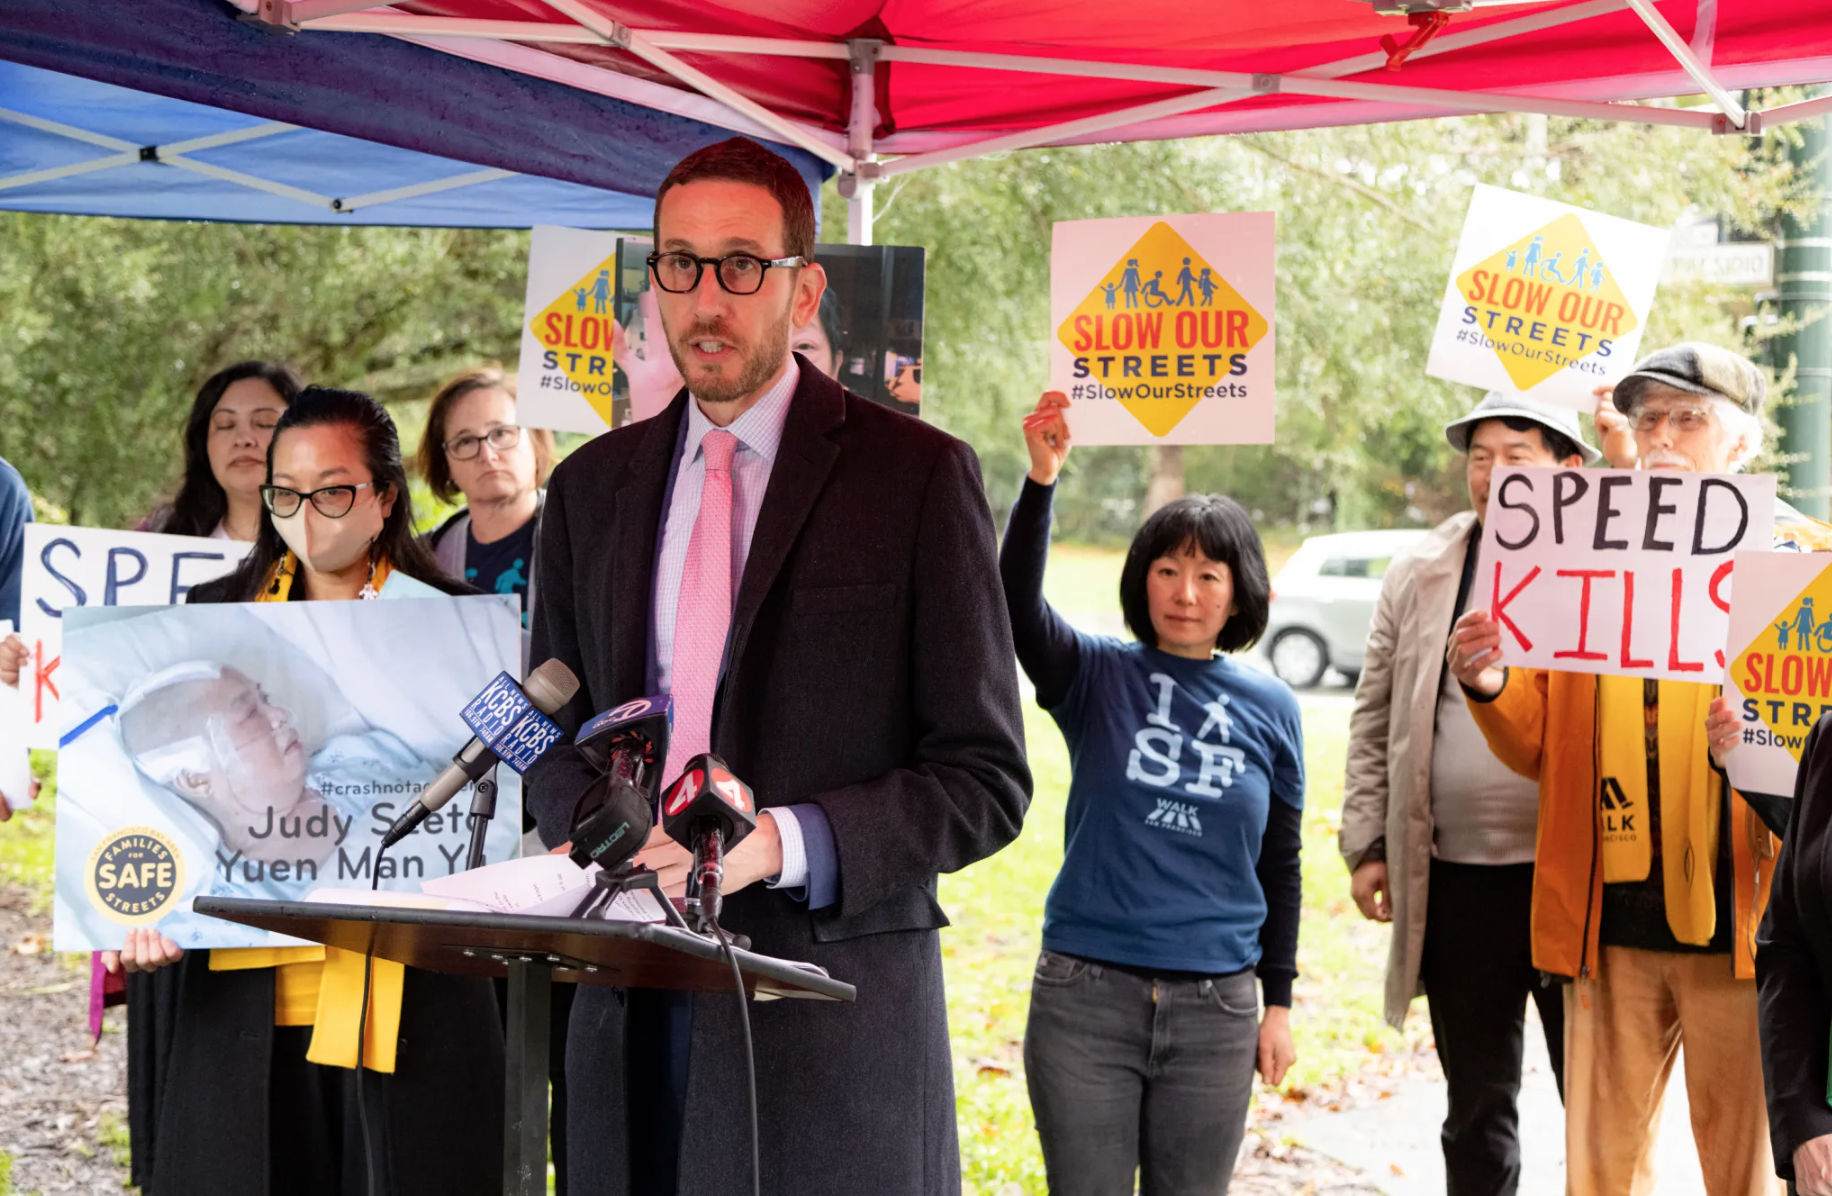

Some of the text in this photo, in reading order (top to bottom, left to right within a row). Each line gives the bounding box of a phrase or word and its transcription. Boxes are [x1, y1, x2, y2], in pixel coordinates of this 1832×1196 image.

[1468, 269, 1625, 336] SLOW OUR
[1073, 309, 1249, 352] SLOW OUR
[1462, 306, 1613, 357] STREETS
[1072, 353, 1248, 379] STREETS
[1456, 329, 1607, 377] #SlowOurStreets
[1071, 382, 1248, 400] #SlowOurStreets
[1494, 471, 1749, 556] SPEED
[498, 676, 529, 710] ALL NEWS
[1744, 652, 1832, 698] SLOW
[470, 698, 505, 736] RADIO
[480, 680, 522, 726] KCBS
[1146, 672, 1181, 732] I
[1742, 698, 1832, 727] STR
[510, 715, 555, 755] KCBS
[528, 709, 562, 739] ALL NEWS
[501, 733, 538, 765] RADIO
[1126, 727, 1246, 798] SF
[669, 771, 698, 814] 4
[716, 778, 745, 811] 4
[1156, 797, 1199, 816] WALK
[248, 802, 474, 846] Judy Set
[1606, 814, 1636, 831] LK
[104, 838, 168, 862] FAMILIES
[216, 849, 317, 883] Yuen
[338, 845, 424, 880] Man
[98, 862, 173, 889] SAFE
[105, 891, 165, 913] STREETS
